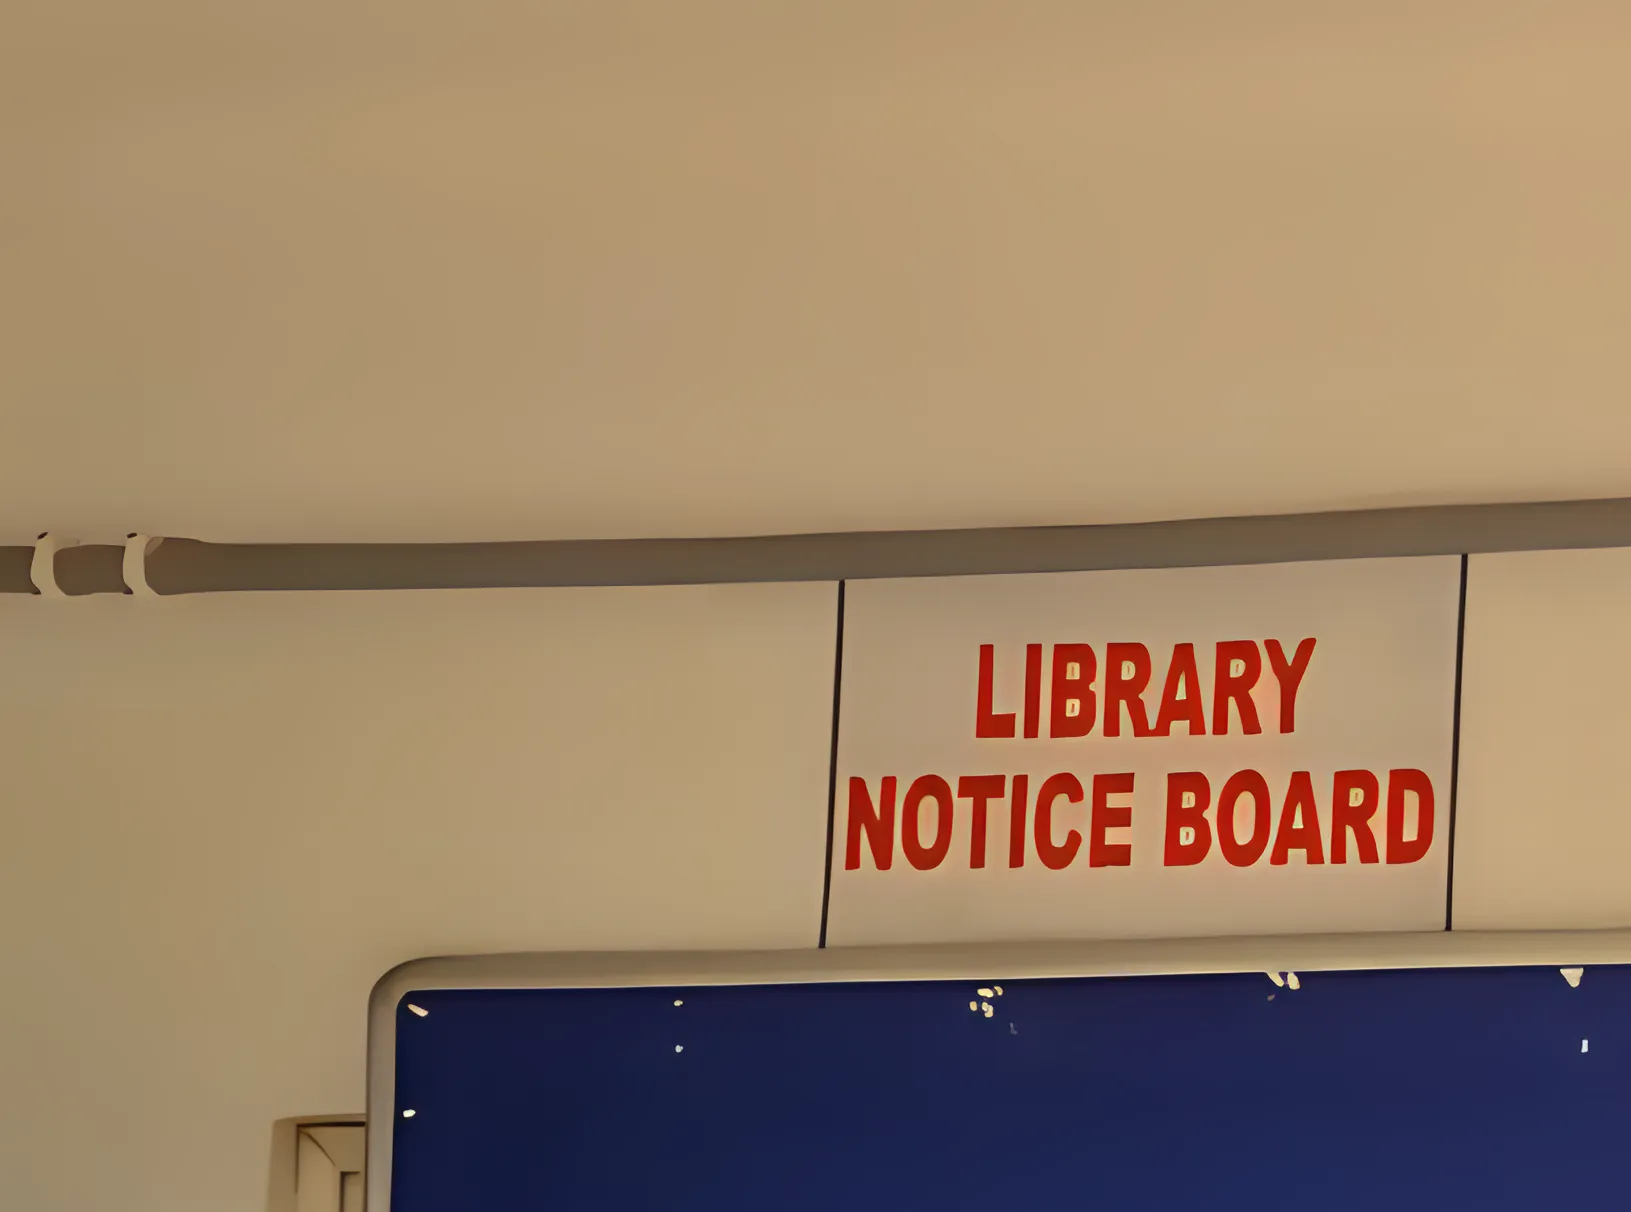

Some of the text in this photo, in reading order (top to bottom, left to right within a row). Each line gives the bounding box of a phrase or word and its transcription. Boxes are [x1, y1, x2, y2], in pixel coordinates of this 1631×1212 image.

[976, 638, 1317, 739] LIBRARY
[845, 769, 1435, 870] NOTICE BOARD
